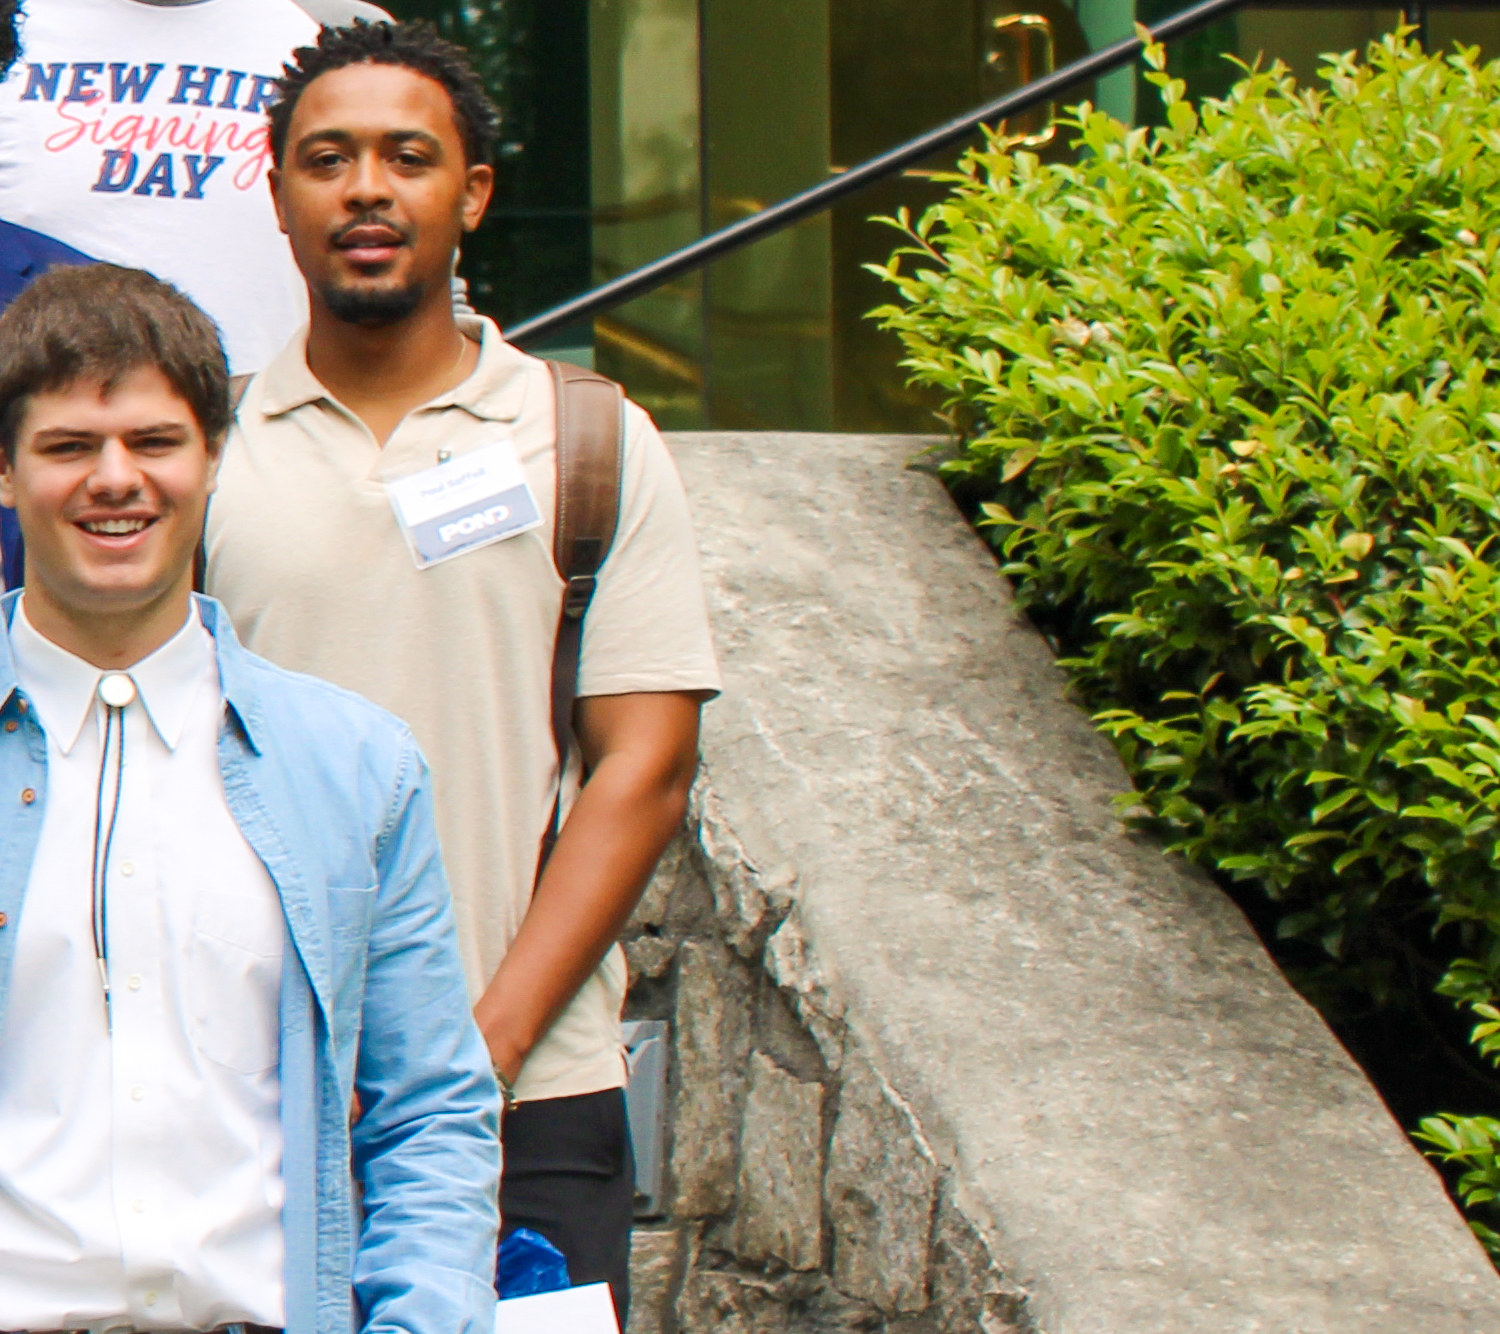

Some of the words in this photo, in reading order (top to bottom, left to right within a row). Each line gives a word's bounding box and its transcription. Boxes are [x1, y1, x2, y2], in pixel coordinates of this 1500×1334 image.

[20, 63, 165, 104] NEW
[168, 64, 285, 114] HIR
[90, 149, 226, 200] DAY
[437, 504, 512, 543] POND
